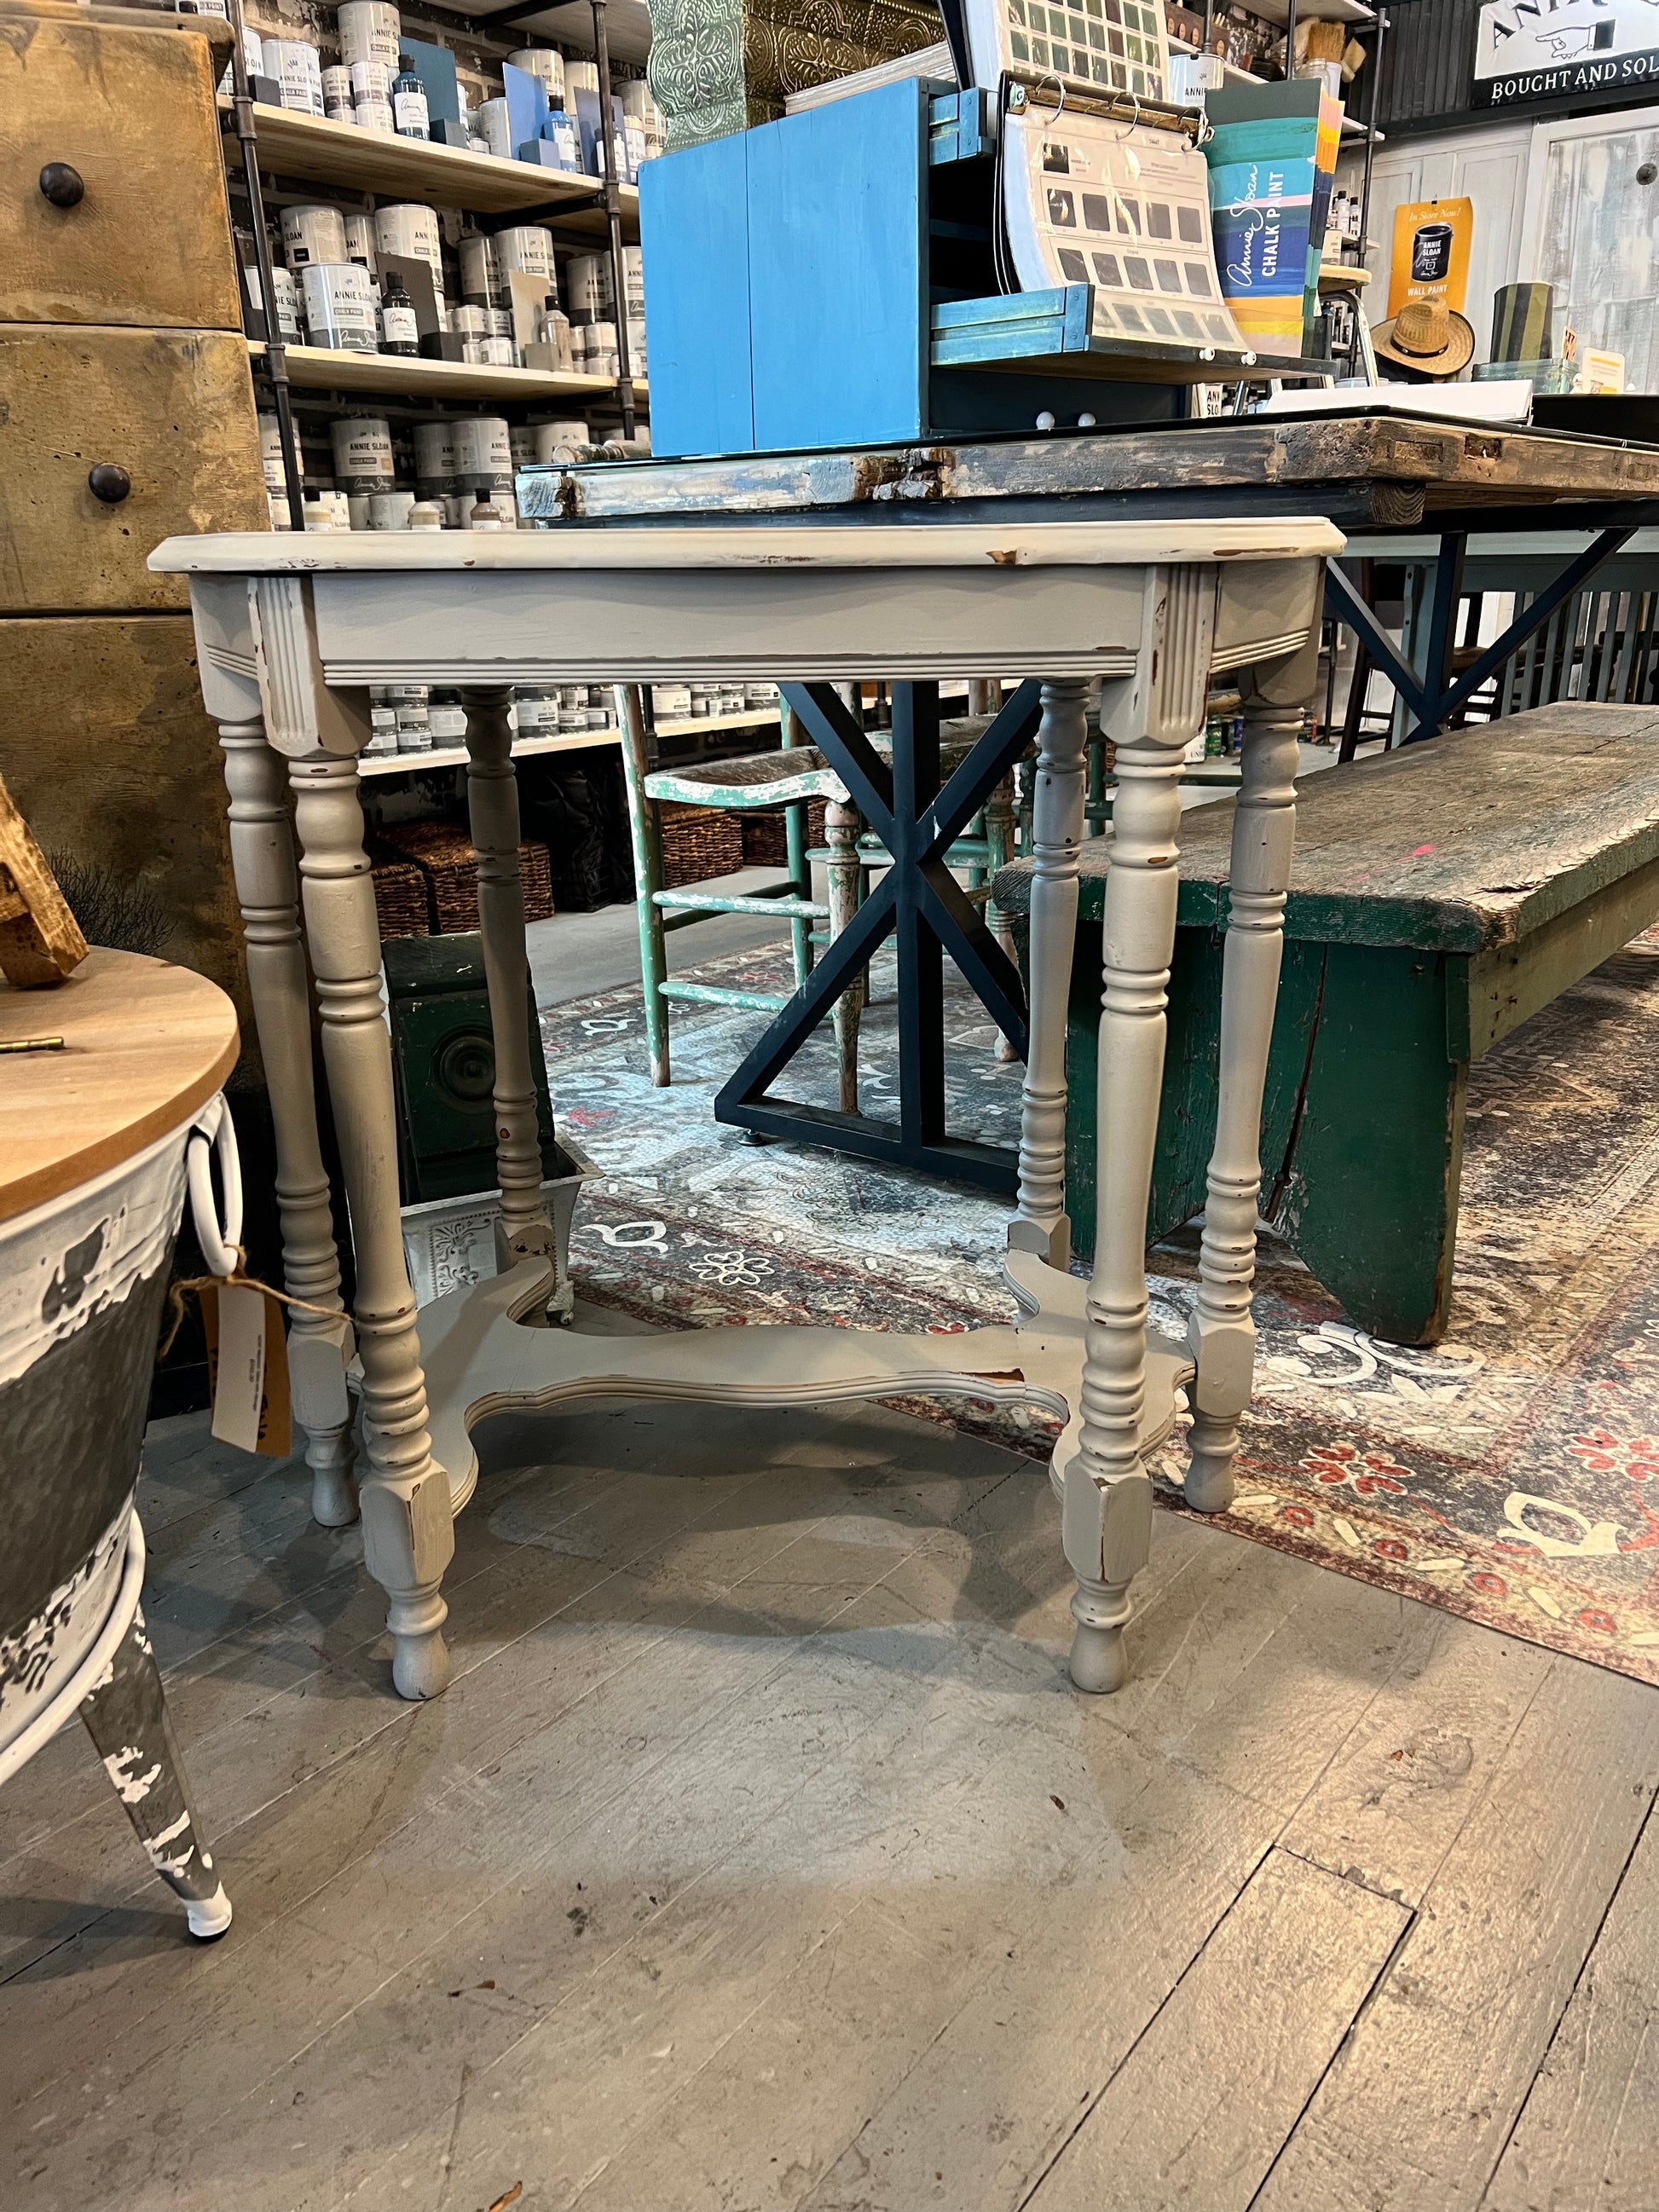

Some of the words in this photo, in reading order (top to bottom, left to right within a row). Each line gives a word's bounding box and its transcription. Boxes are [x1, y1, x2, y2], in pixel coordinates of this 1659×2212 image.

[1491, 70, 1571, 100] BOUGHT
[1575, 62, 1617, 85] AND
[1229, 164, 1263, 232] Sloan
[1267, 171, 1284, 218] PAINT
[1409, 212, 1418, 222] In
[1419, 211, 1439, 220] Store
[1441, 207, 1461, 217] Now!
[1262, 224, 1280, 277] CHALK
[1423, 240, 1442, 249] ANNIE
[1227, 225, 1254, 286] Annie
[1422, 247, 1442, 257] SLOAN
[335, 291, 357, 300] ANNIE
[1408, 286, 1425, 296] WALL
[1428, 285, 1448, 295] PAINT
[1206, 390, 1220, 402] ANN
[1206, 404, 1219, 416] SLO
[350, 442, 371, 451] ANNIE
